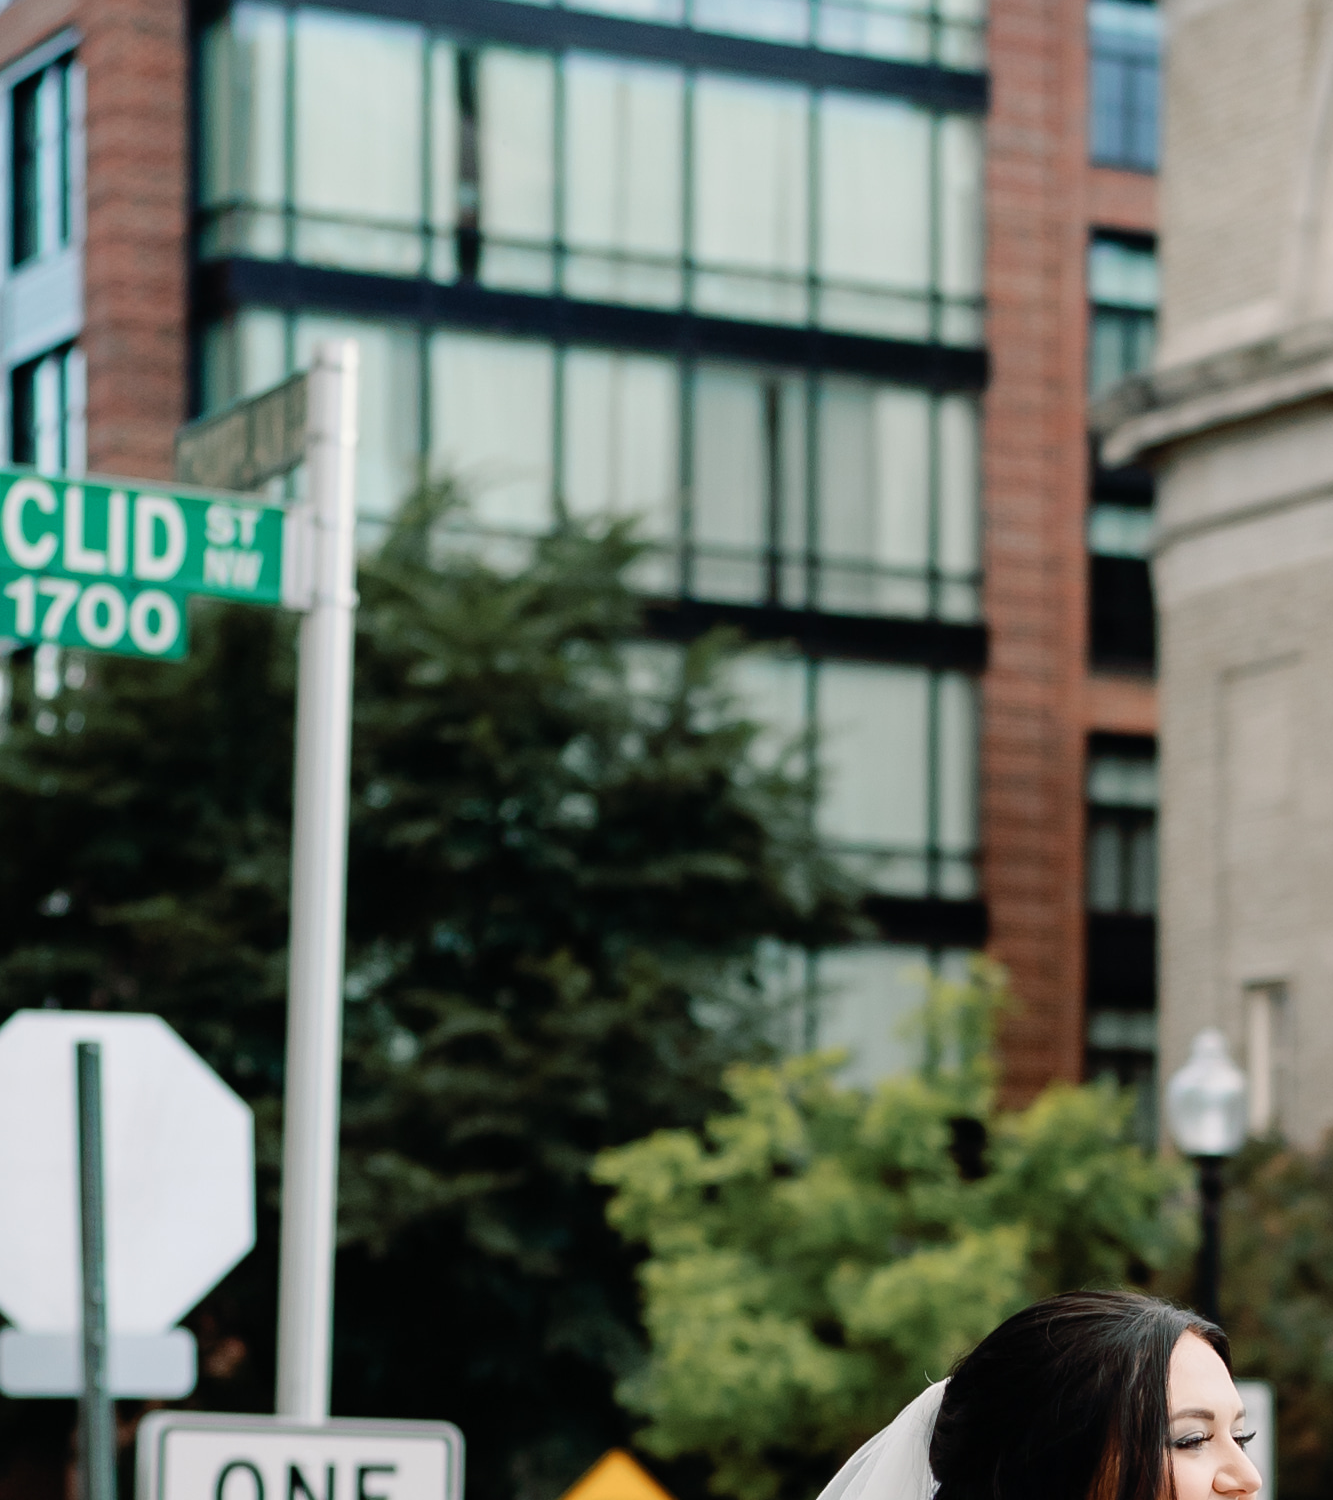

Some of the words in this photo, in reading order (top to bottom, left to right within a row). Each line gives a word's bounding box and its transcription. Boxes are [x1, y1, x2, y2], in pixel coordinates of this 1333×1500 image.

[2, 477, 187, 582] CLID
[205, 502, 262, 548] ST
[202, 546, 264, 591] NW
[3, 574, 181, 655] 1700
